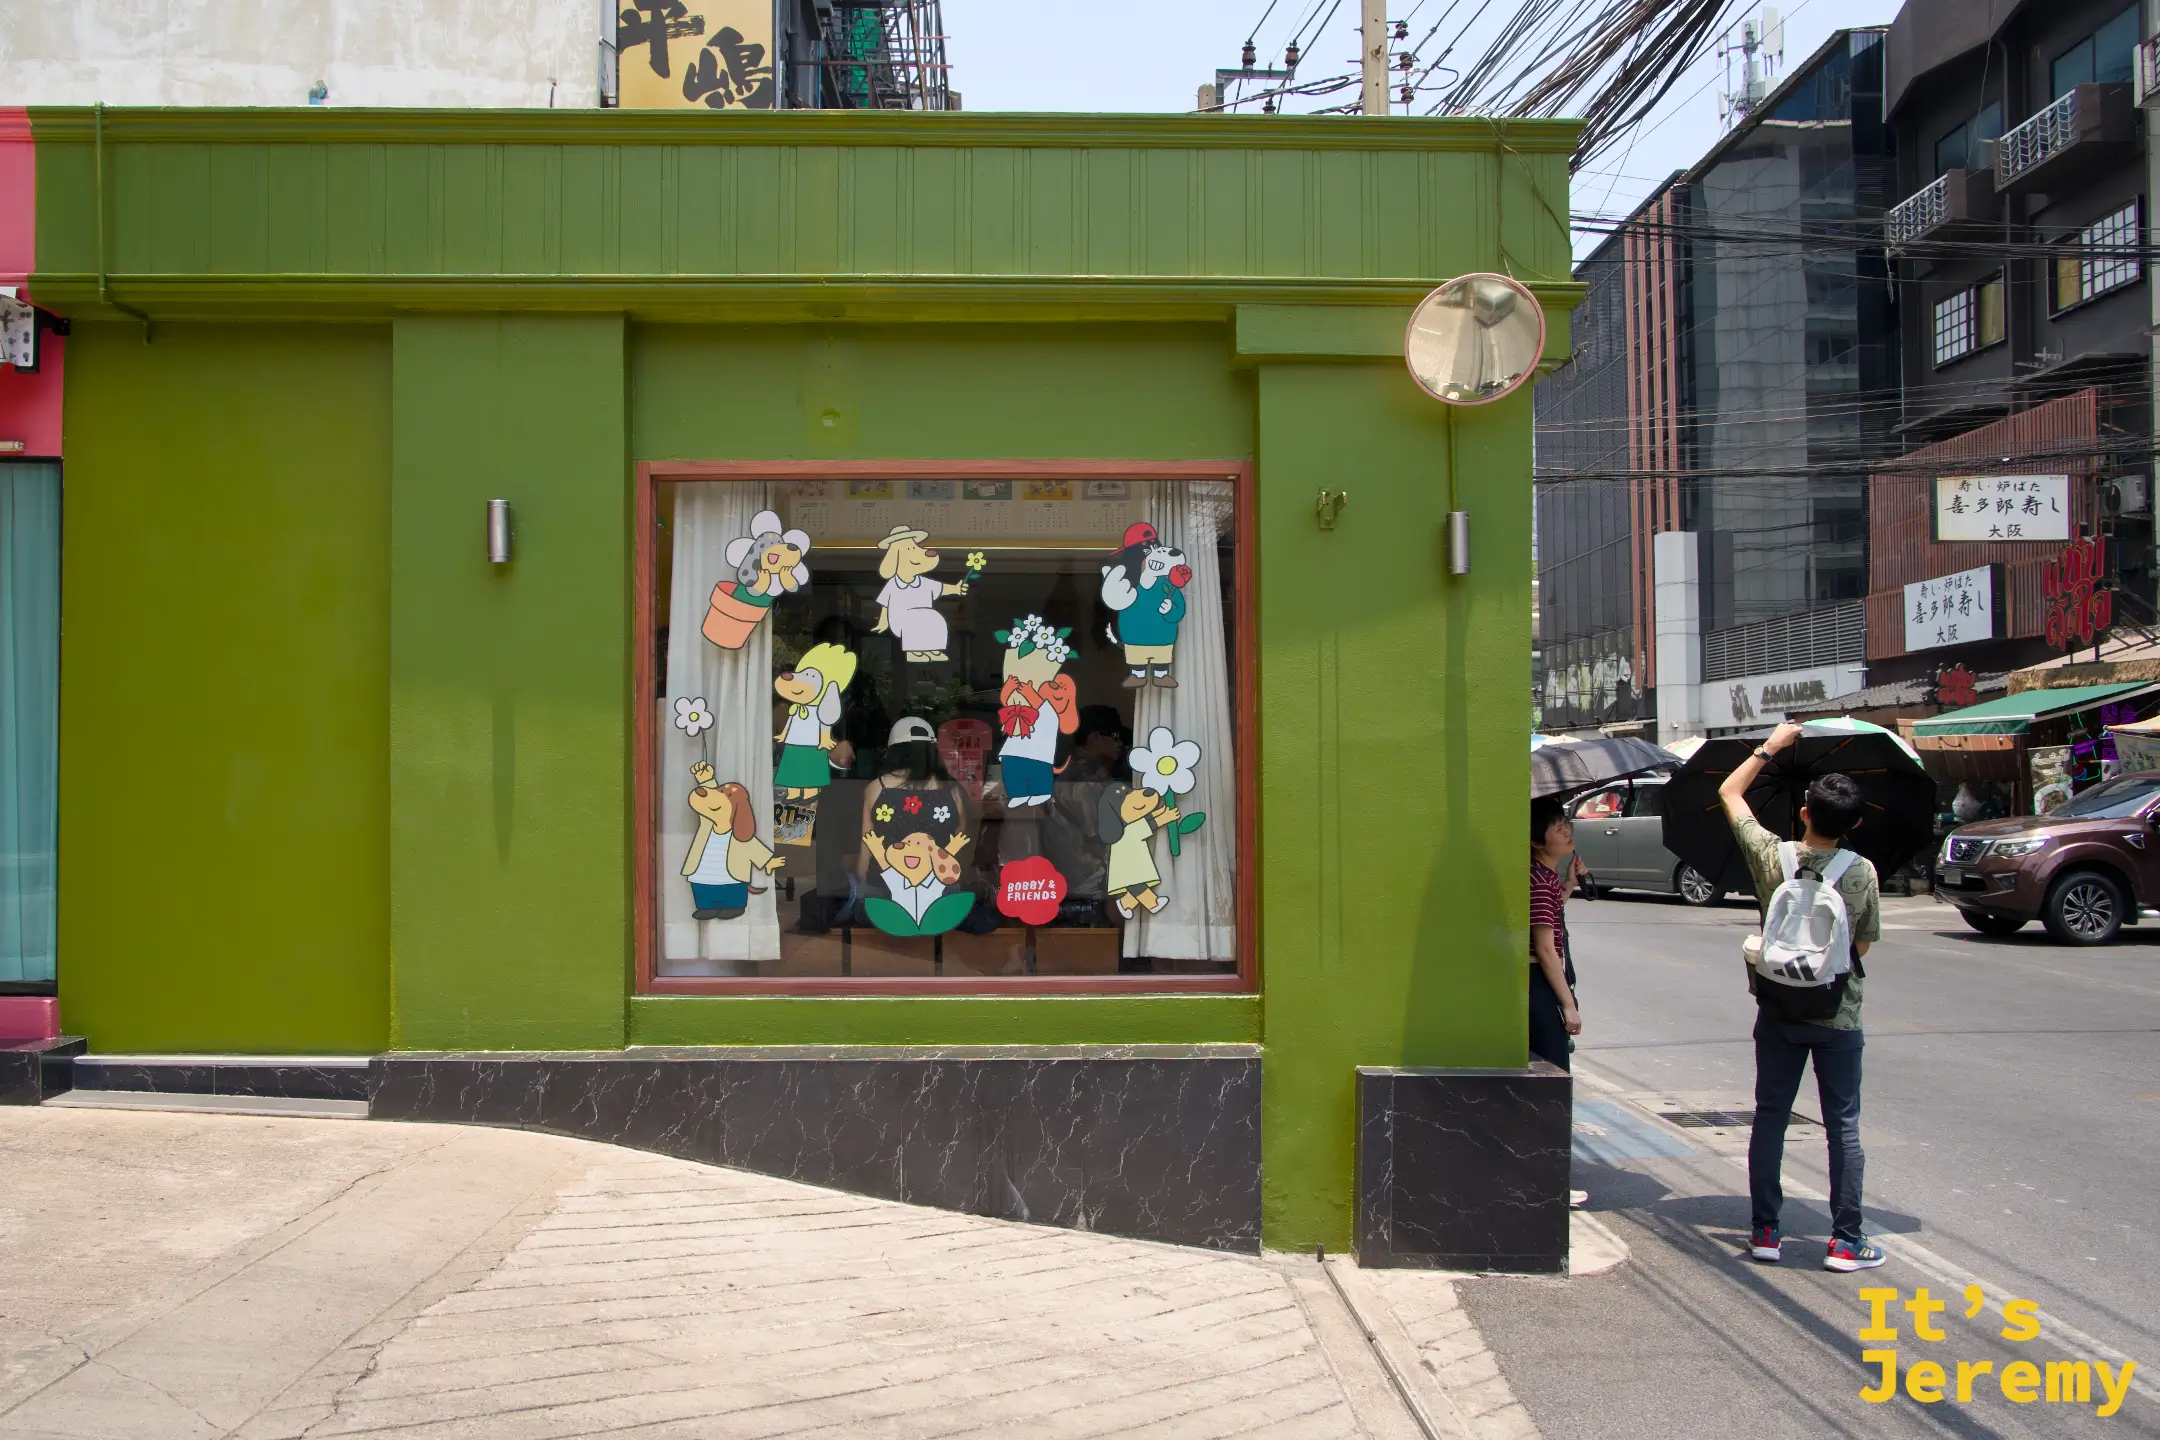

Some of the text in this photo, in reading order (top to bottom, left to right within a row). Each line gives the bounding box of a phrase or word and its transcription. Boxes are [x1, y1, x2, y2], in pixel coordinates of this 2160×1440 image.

[1944, 494, 2061, 516] 喜多郎寿し
[1988, 524, 2024, 539] 大阪
[1912, 590, 1984, 624] 喜多郎寿し
[1936, 624, 1958, 644] 大阪
[1007, 879, 1056, 893] BOBBY &
[1007, 890, 1057, 902] FRIENDS
